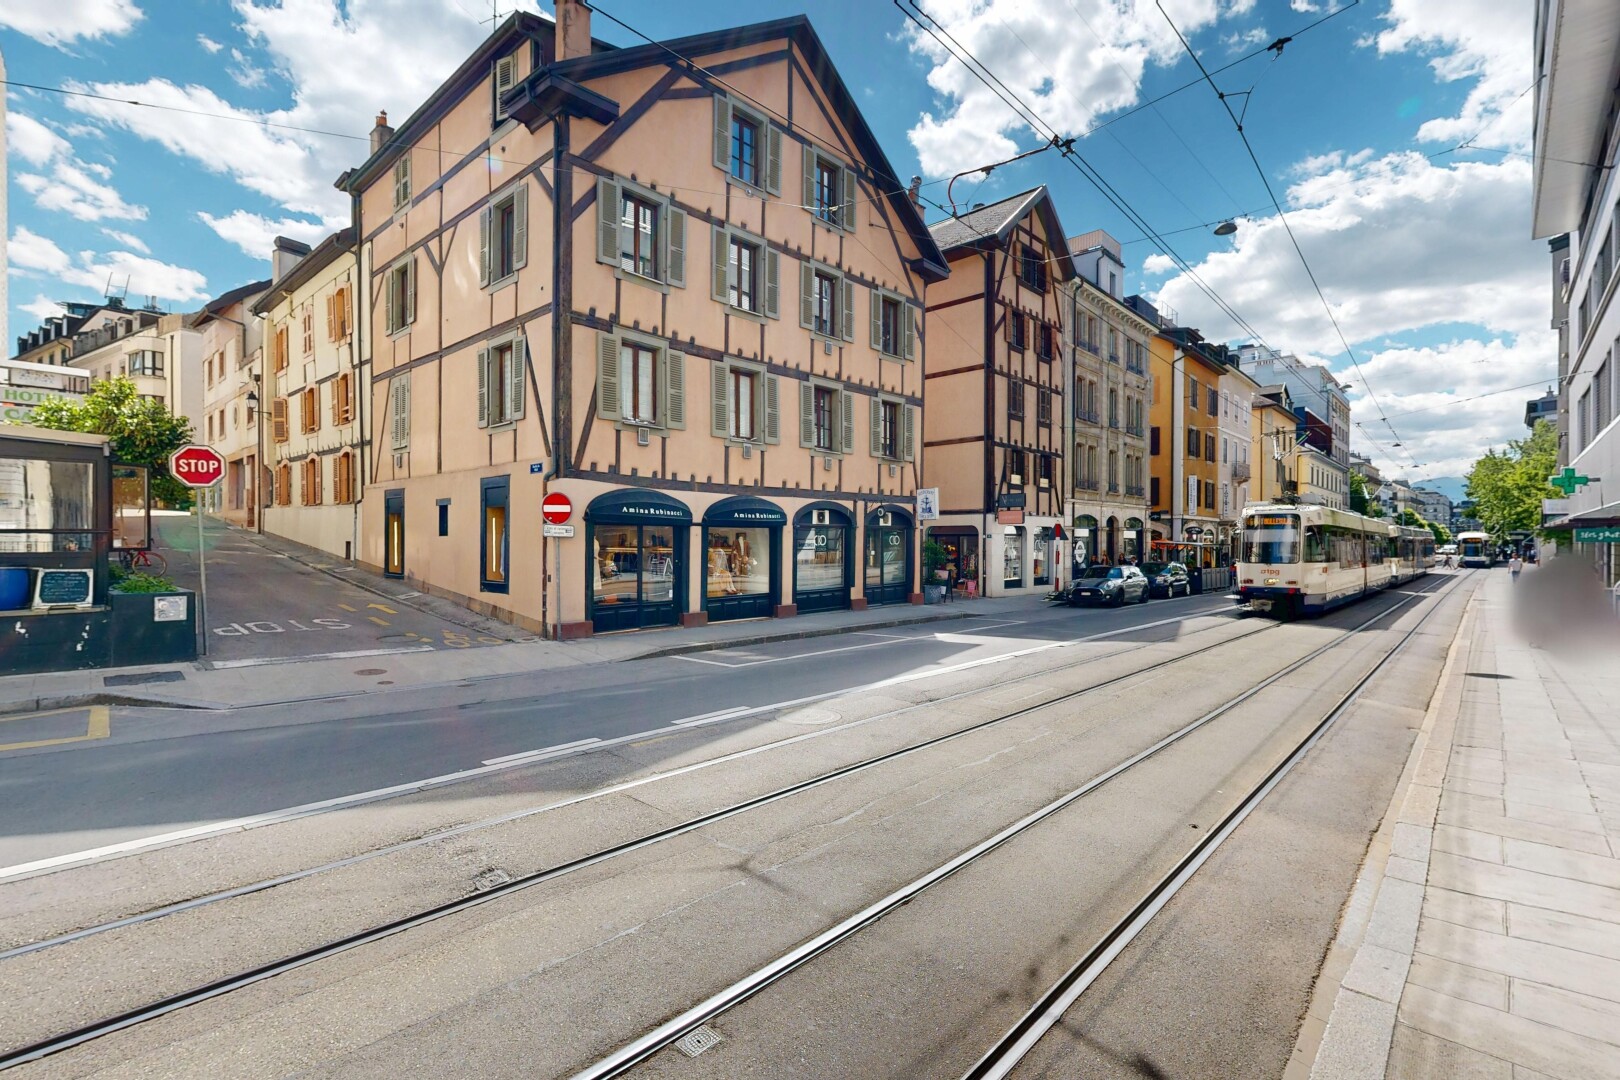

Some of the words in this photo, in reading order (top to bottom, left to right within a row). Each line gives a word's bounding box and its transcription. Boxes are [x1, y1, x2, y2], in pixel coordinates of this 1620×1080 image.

[179, 459, 219, 473] STOP
[622, 506, 648, 514] Amina
[650, 508, 683, 517] Rubinacci
[212, 618, 352, 636] STOP
